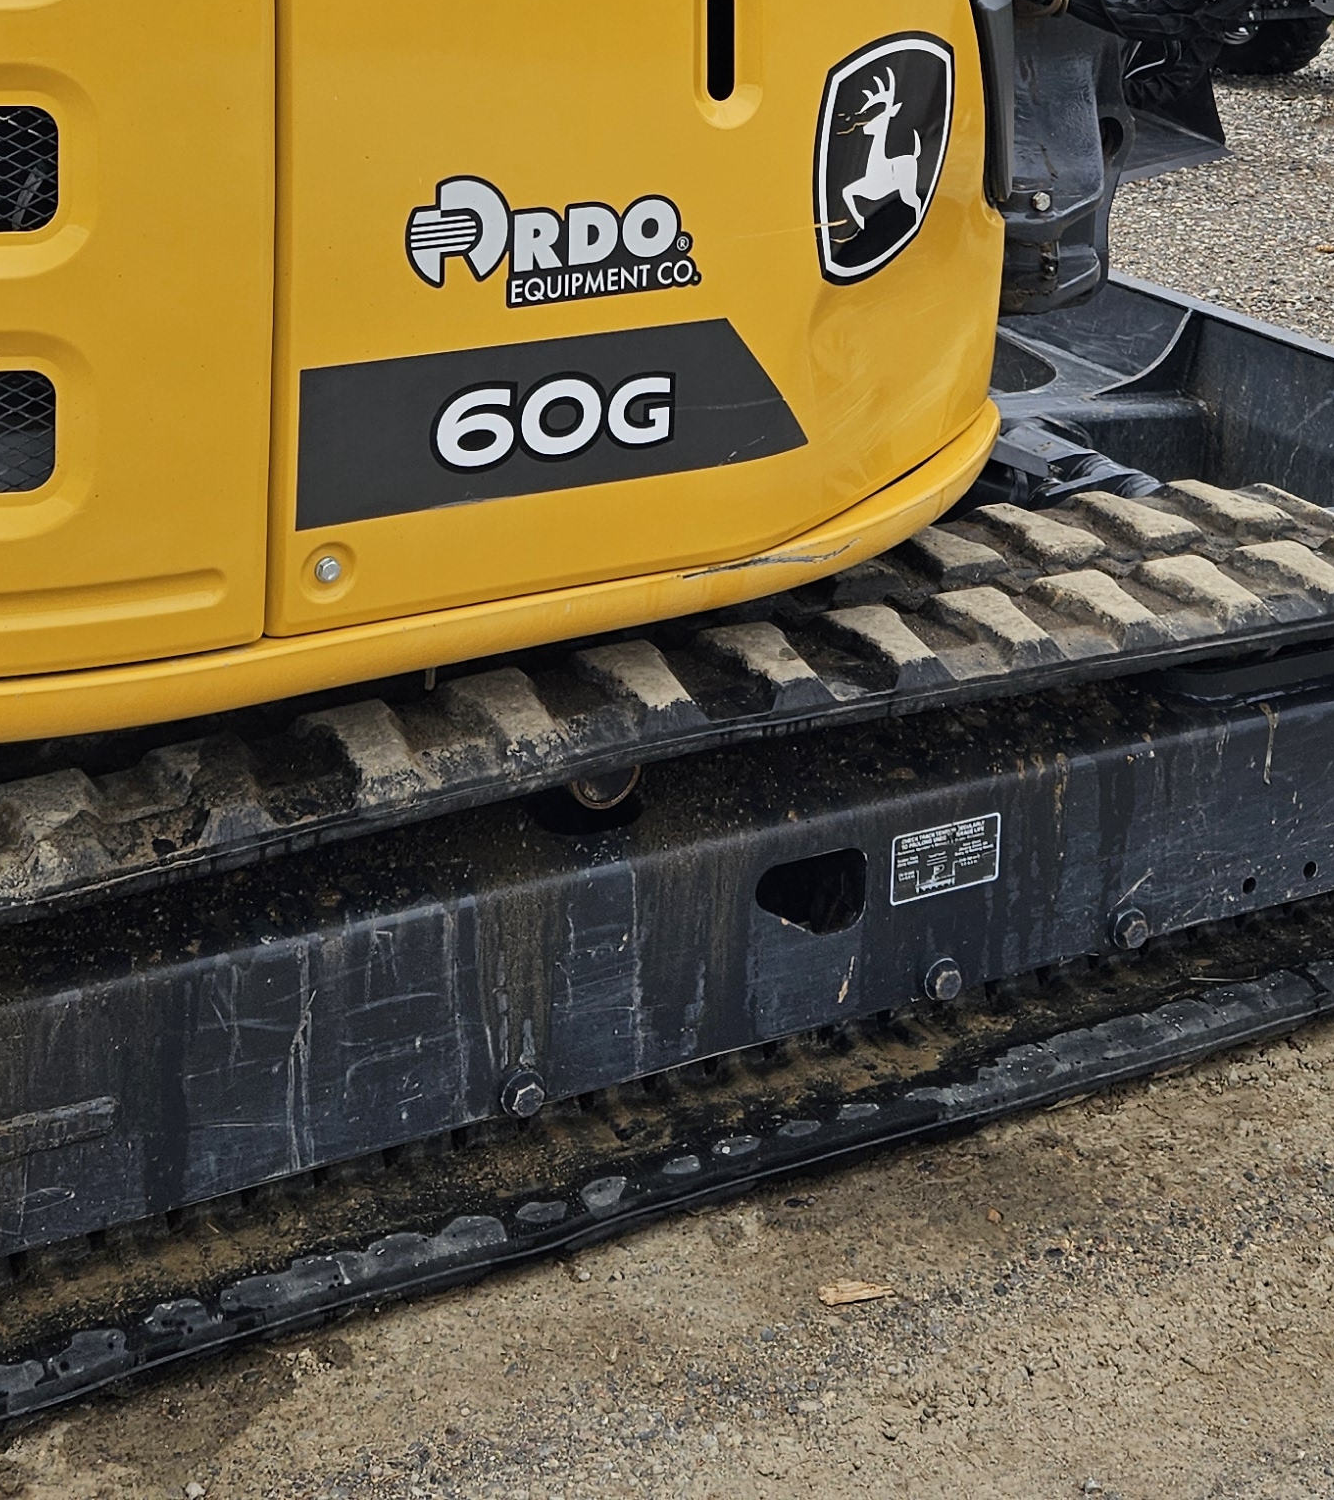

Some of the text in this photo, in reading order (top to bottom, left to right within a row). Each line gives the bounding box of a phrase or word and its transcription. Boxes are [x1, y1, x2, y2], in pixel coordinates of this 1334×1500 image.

[511, 260, 699, 304] EQUIPMENT CO.
[434, 376, 672, 468] 60G
